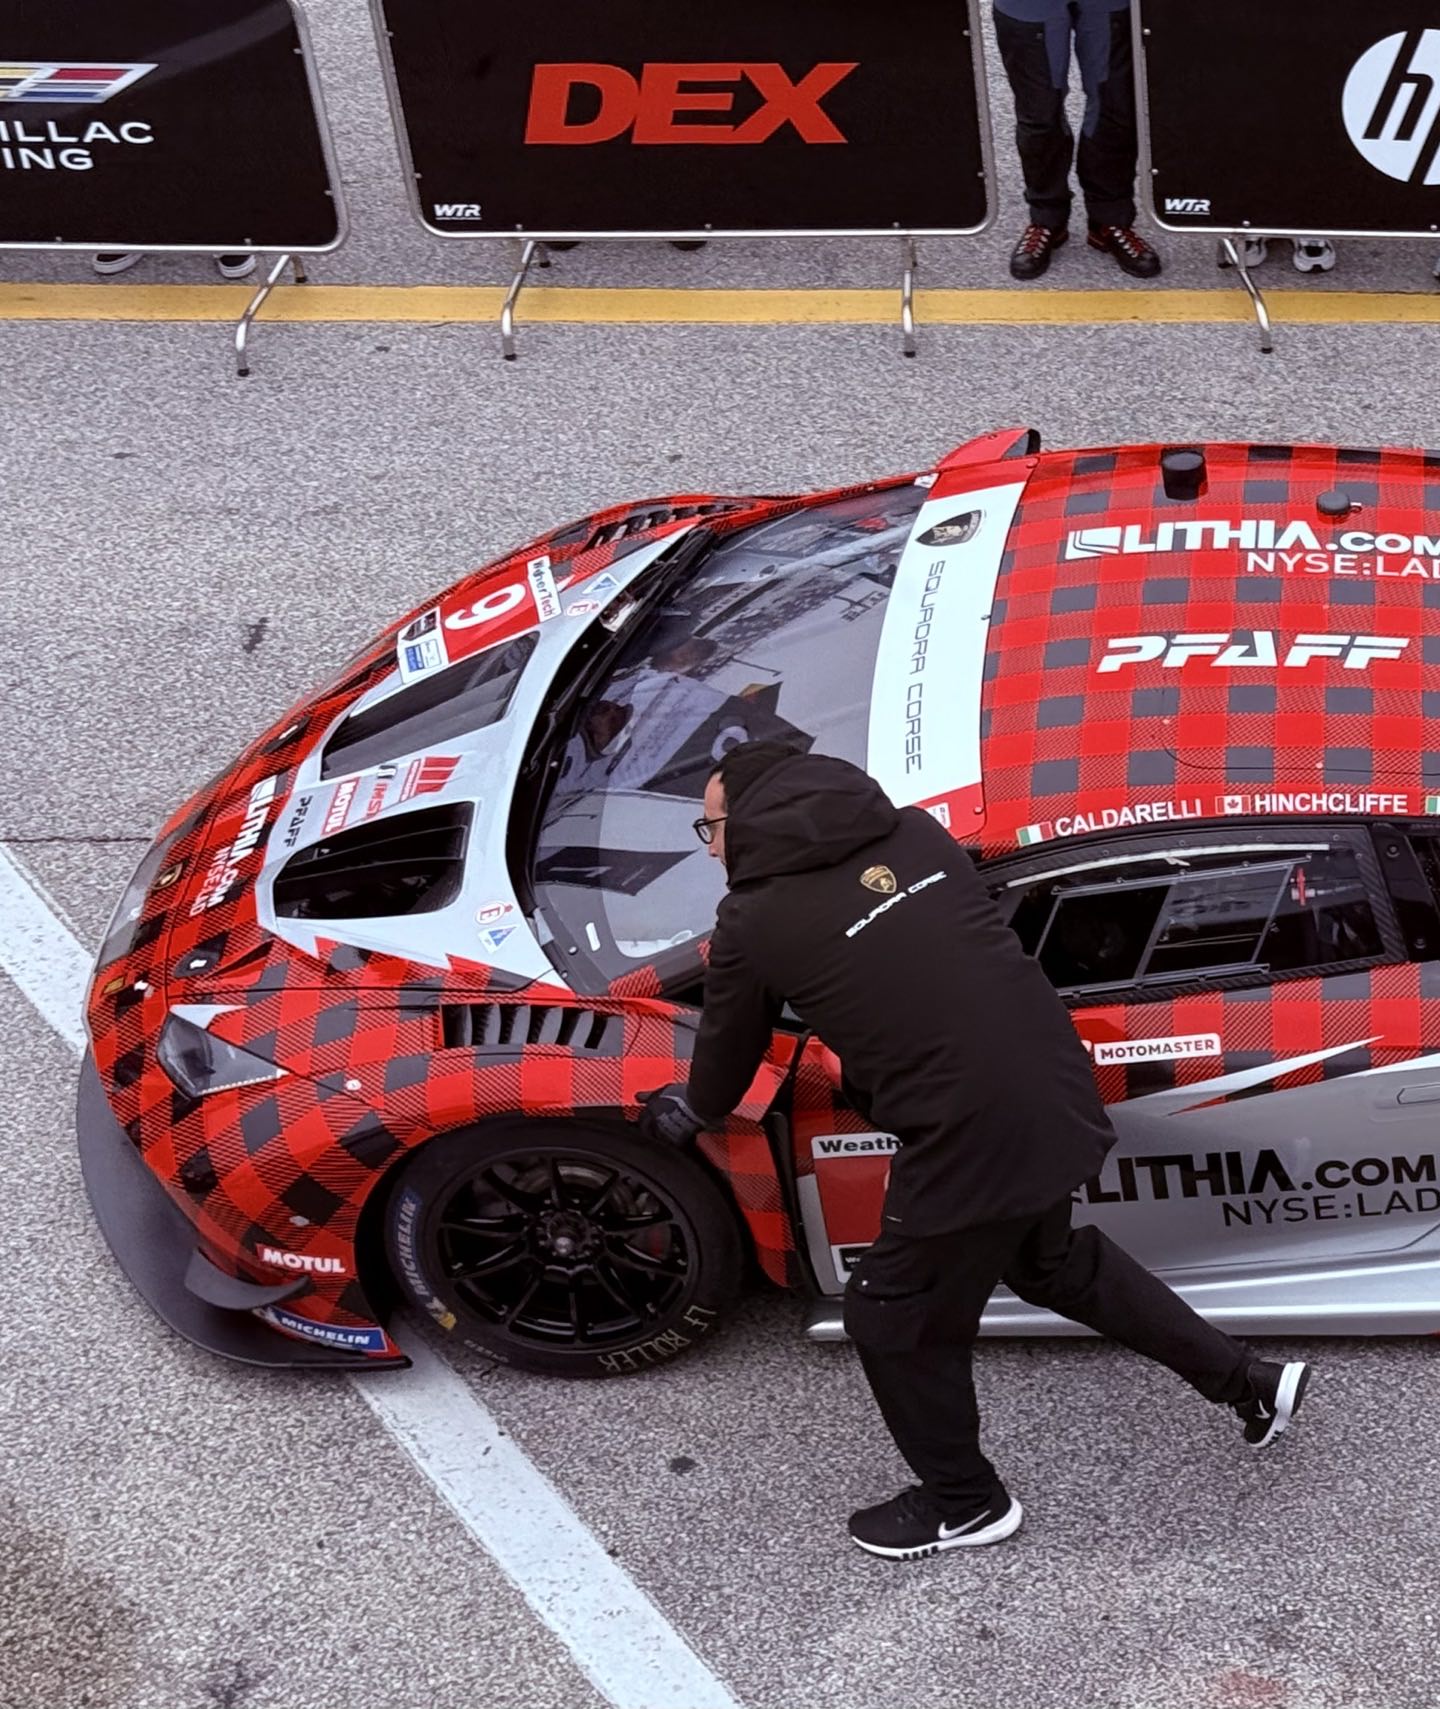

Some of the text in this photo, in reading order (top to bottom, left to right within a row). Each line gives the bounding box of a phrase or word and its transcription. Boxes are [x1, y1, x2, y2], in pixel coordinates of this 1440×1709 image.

[524, 63, 860, 144] DEX
[434, 204, 481, 217] WTR
[1164, 198, 1211, 213] WTR
[444, 583, 527, 630] 9
[906, 560, 946, 774] SQUADRA CORSE
[1096, 630, 1409, 673] PFAFF
[285, 795, 313, 848] PFAFF
[324, 781, 357, 833] MOTUL
[1055, 798, 1202, 837] CALDARELLI
[1254, 793, 1408, 813] HINCHCLIFFE
[207, 795, 274, 908] LITHIA.COM
[1100, 1039, 1215, 1060] MOTOMASTER
[1086, 1149, 1437, 1204] LITHIA.COM
[263, 1248, 346, 1273] MOTUL
[281, 1316, 371, 1346] MICHELIN
[597, 1329, 692, 1371] ROLLER
